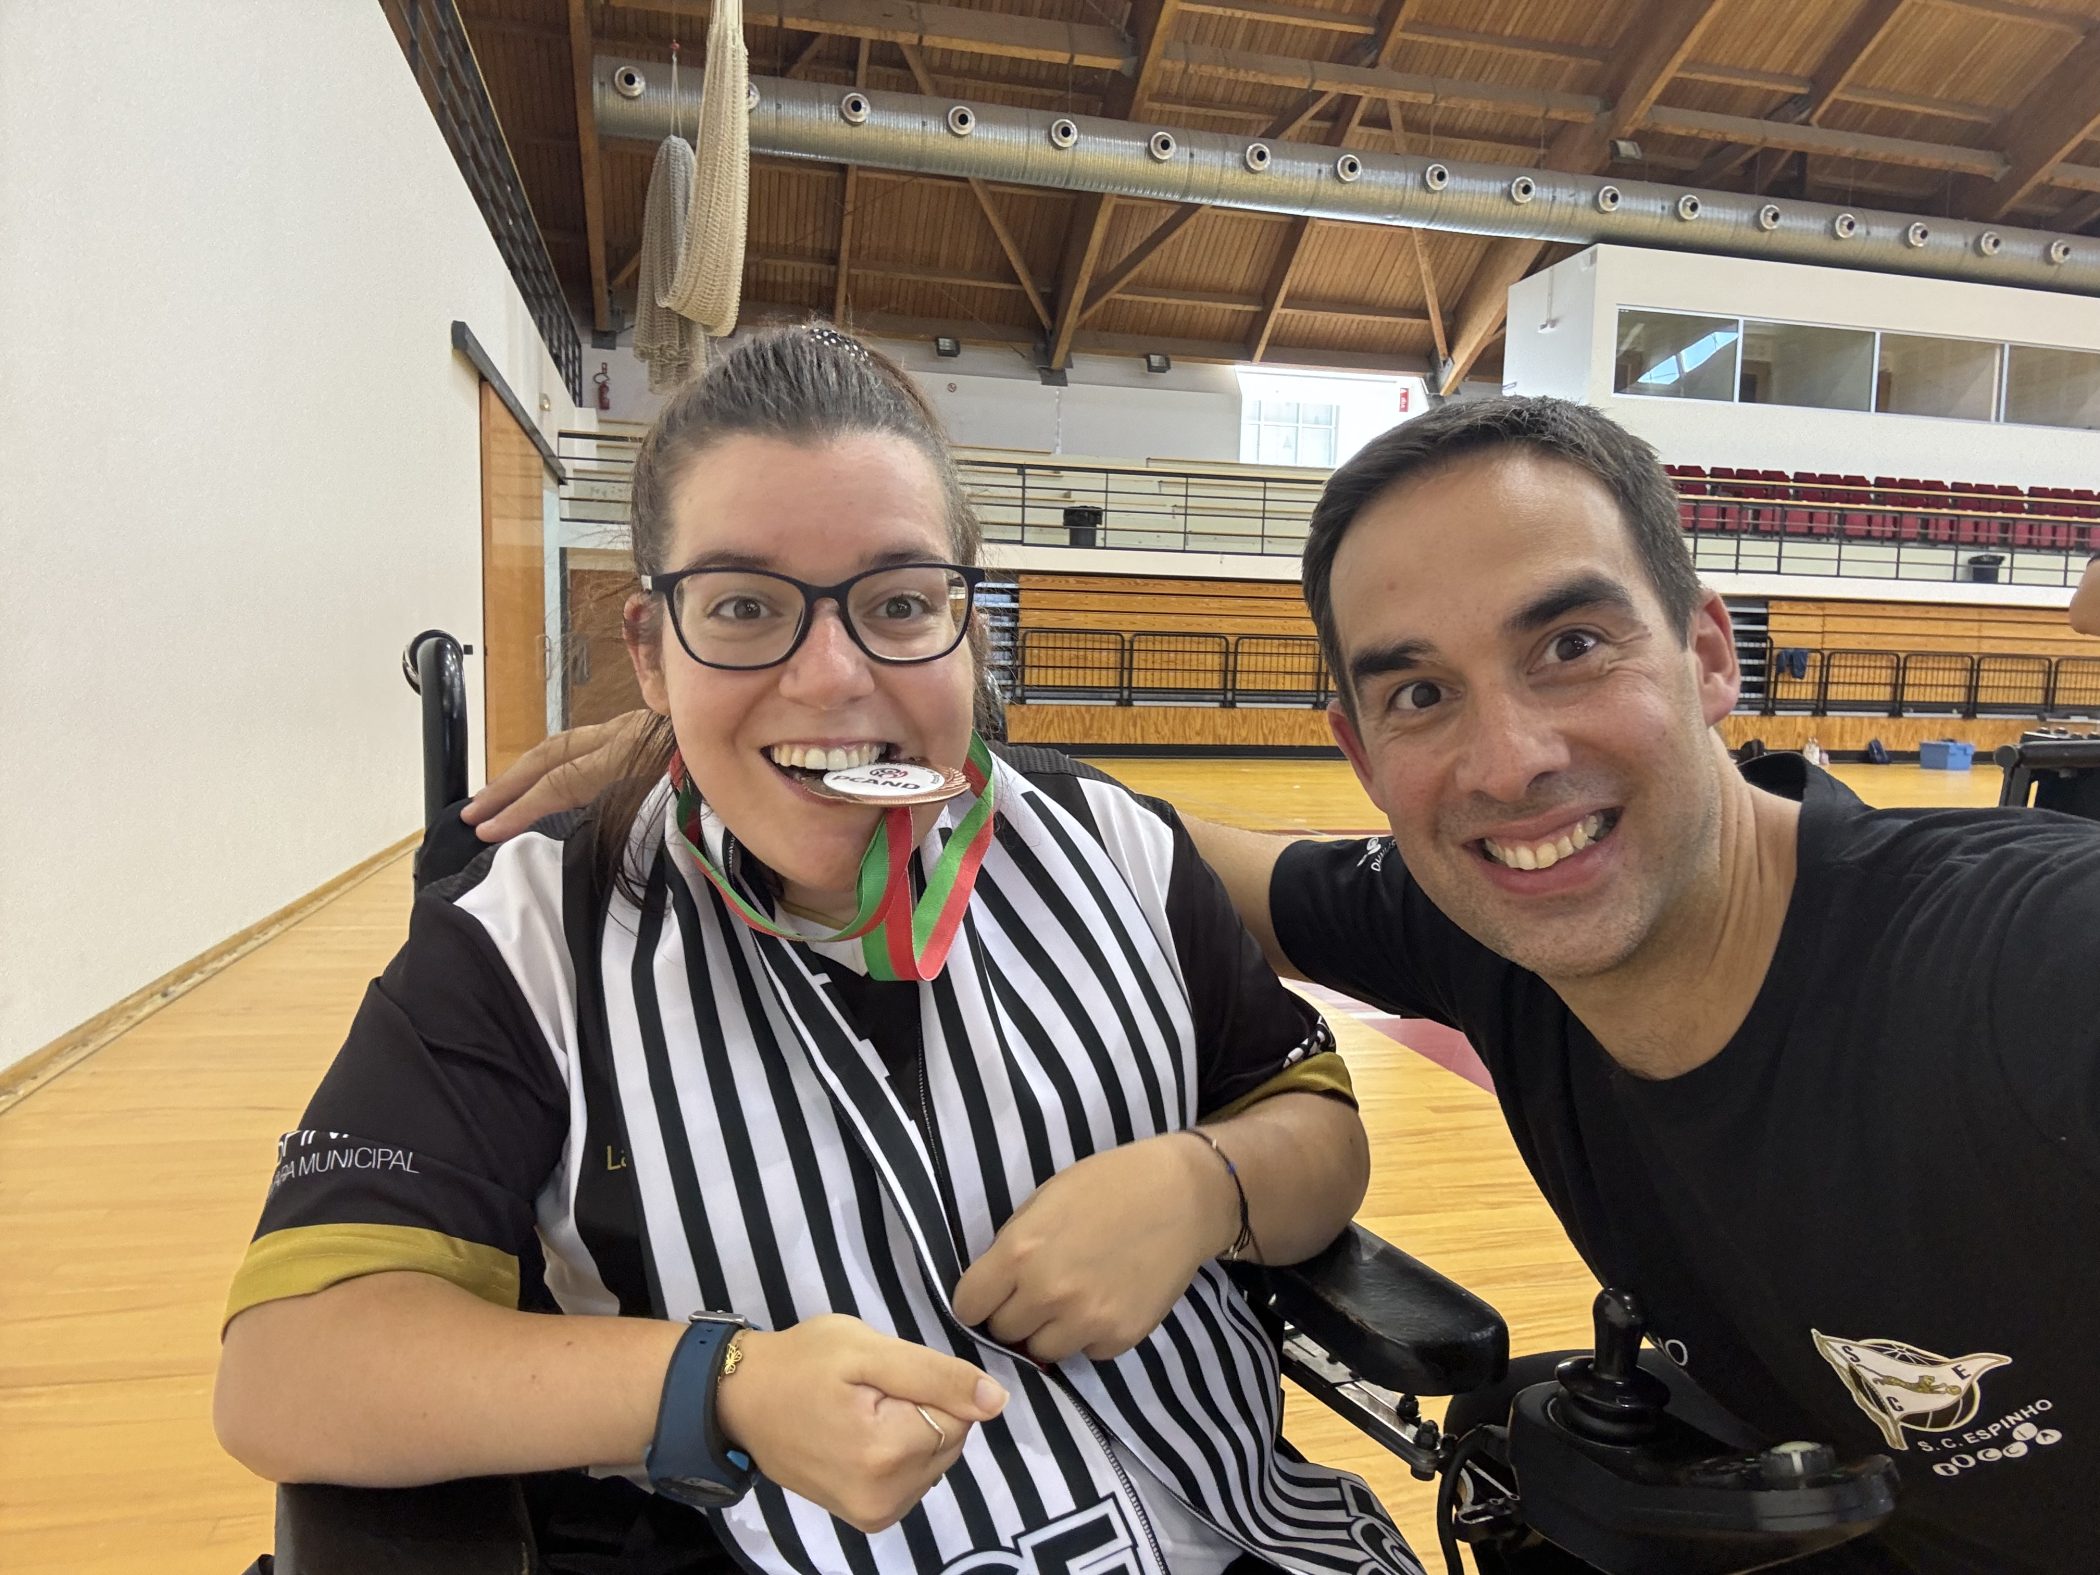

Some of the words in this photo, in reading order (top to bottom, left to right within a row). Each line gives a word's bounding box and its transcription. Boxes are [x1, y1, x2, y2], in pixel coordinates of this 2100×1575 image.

[831, 775, 921, 790] PCAND
[298, 1147, 421, 1177] MUNICIPAL
[1841, 1345, 1861, 1363] S
[1951, 1364, 1972, 1381] E
[1886, 1396, 1905, 1412] C
[1962, 1399, 2053, 1444] ESPINHO
